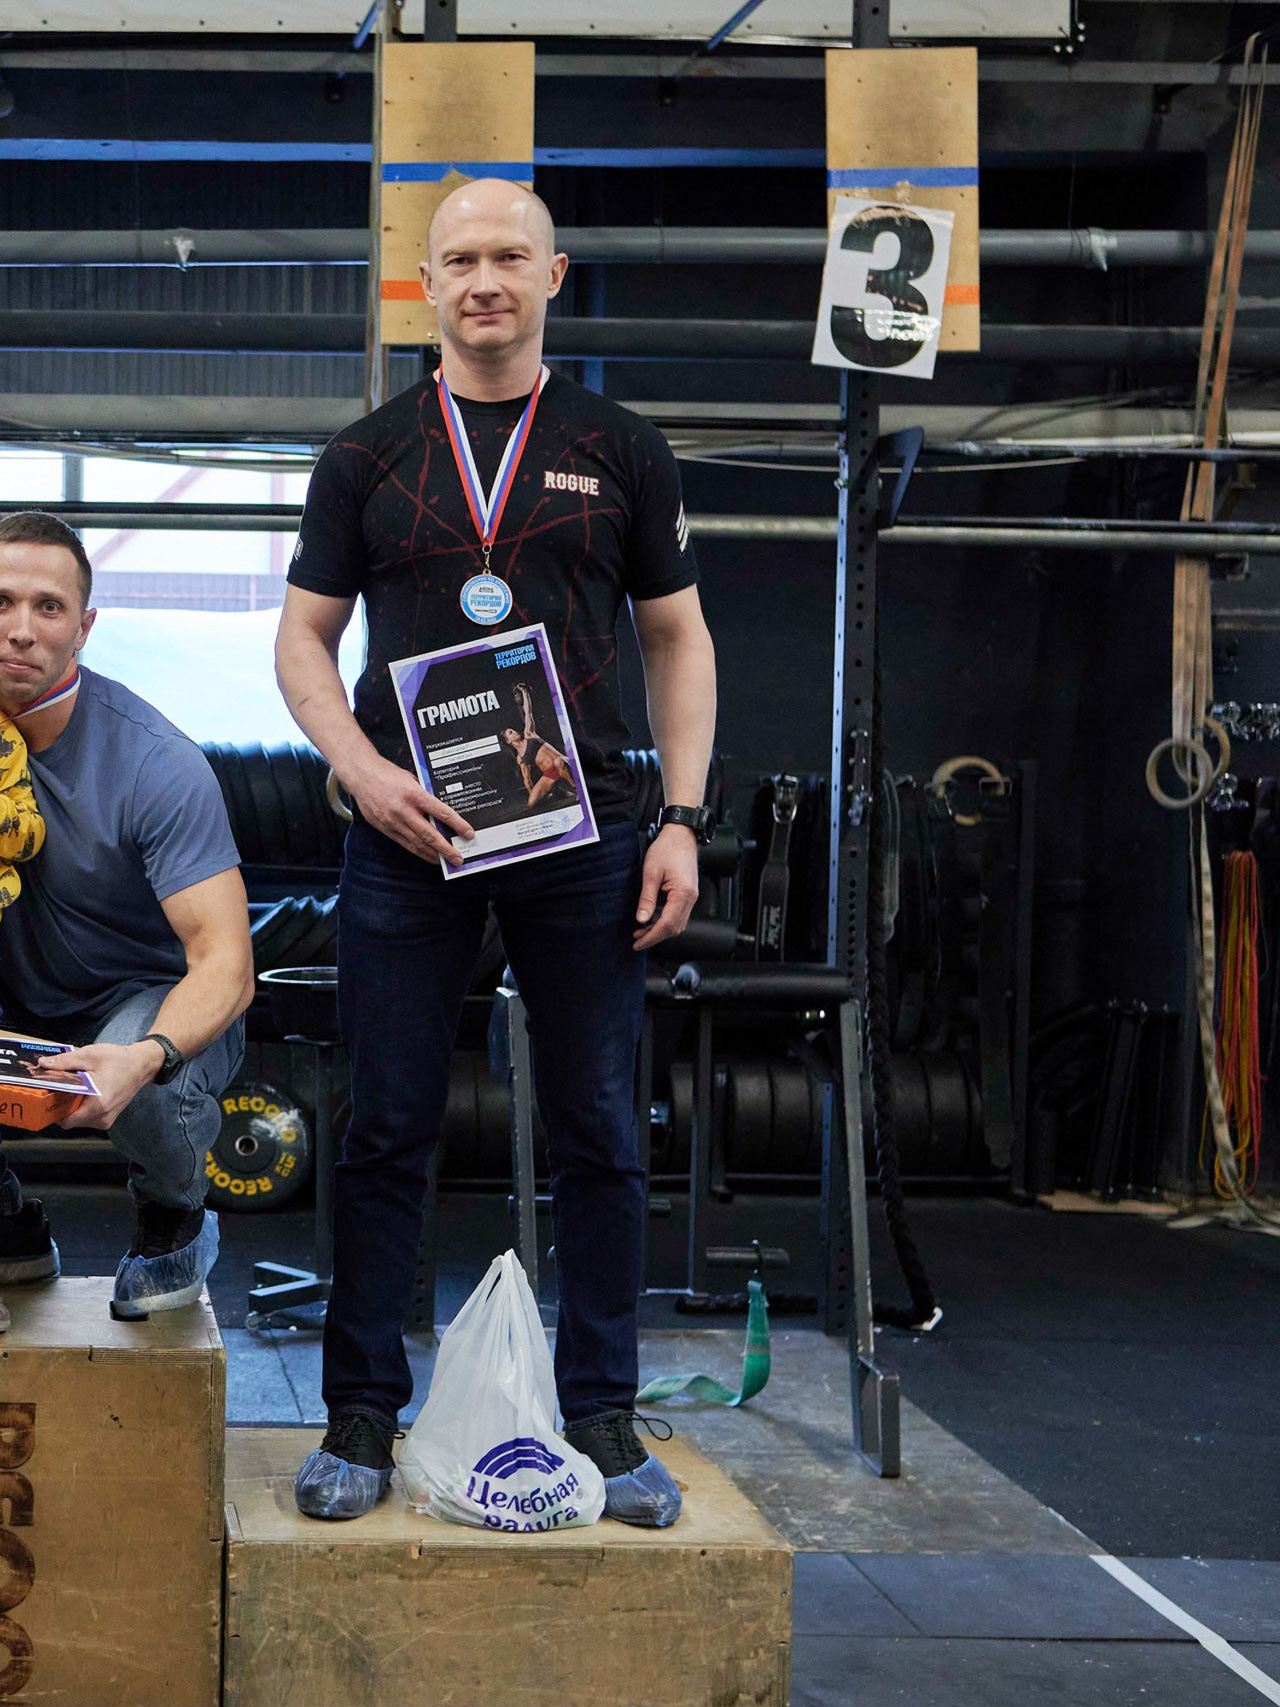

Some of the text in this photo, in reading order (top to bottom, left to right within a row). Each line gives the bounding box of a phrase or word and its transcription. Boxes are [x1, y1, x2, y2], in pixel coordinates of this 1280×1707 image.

[830, 204, 935, 369] 3
[543, 470, 599, 496] ROGUE
[494, 643, 535, 661] ТЕРРИТОРИЯ
[495, 651, 537, 670] РЕКОРДОВ
[416, 690, 500, 729] ГРАМОТА
[466, 1472, 580, 1515] Целебная
